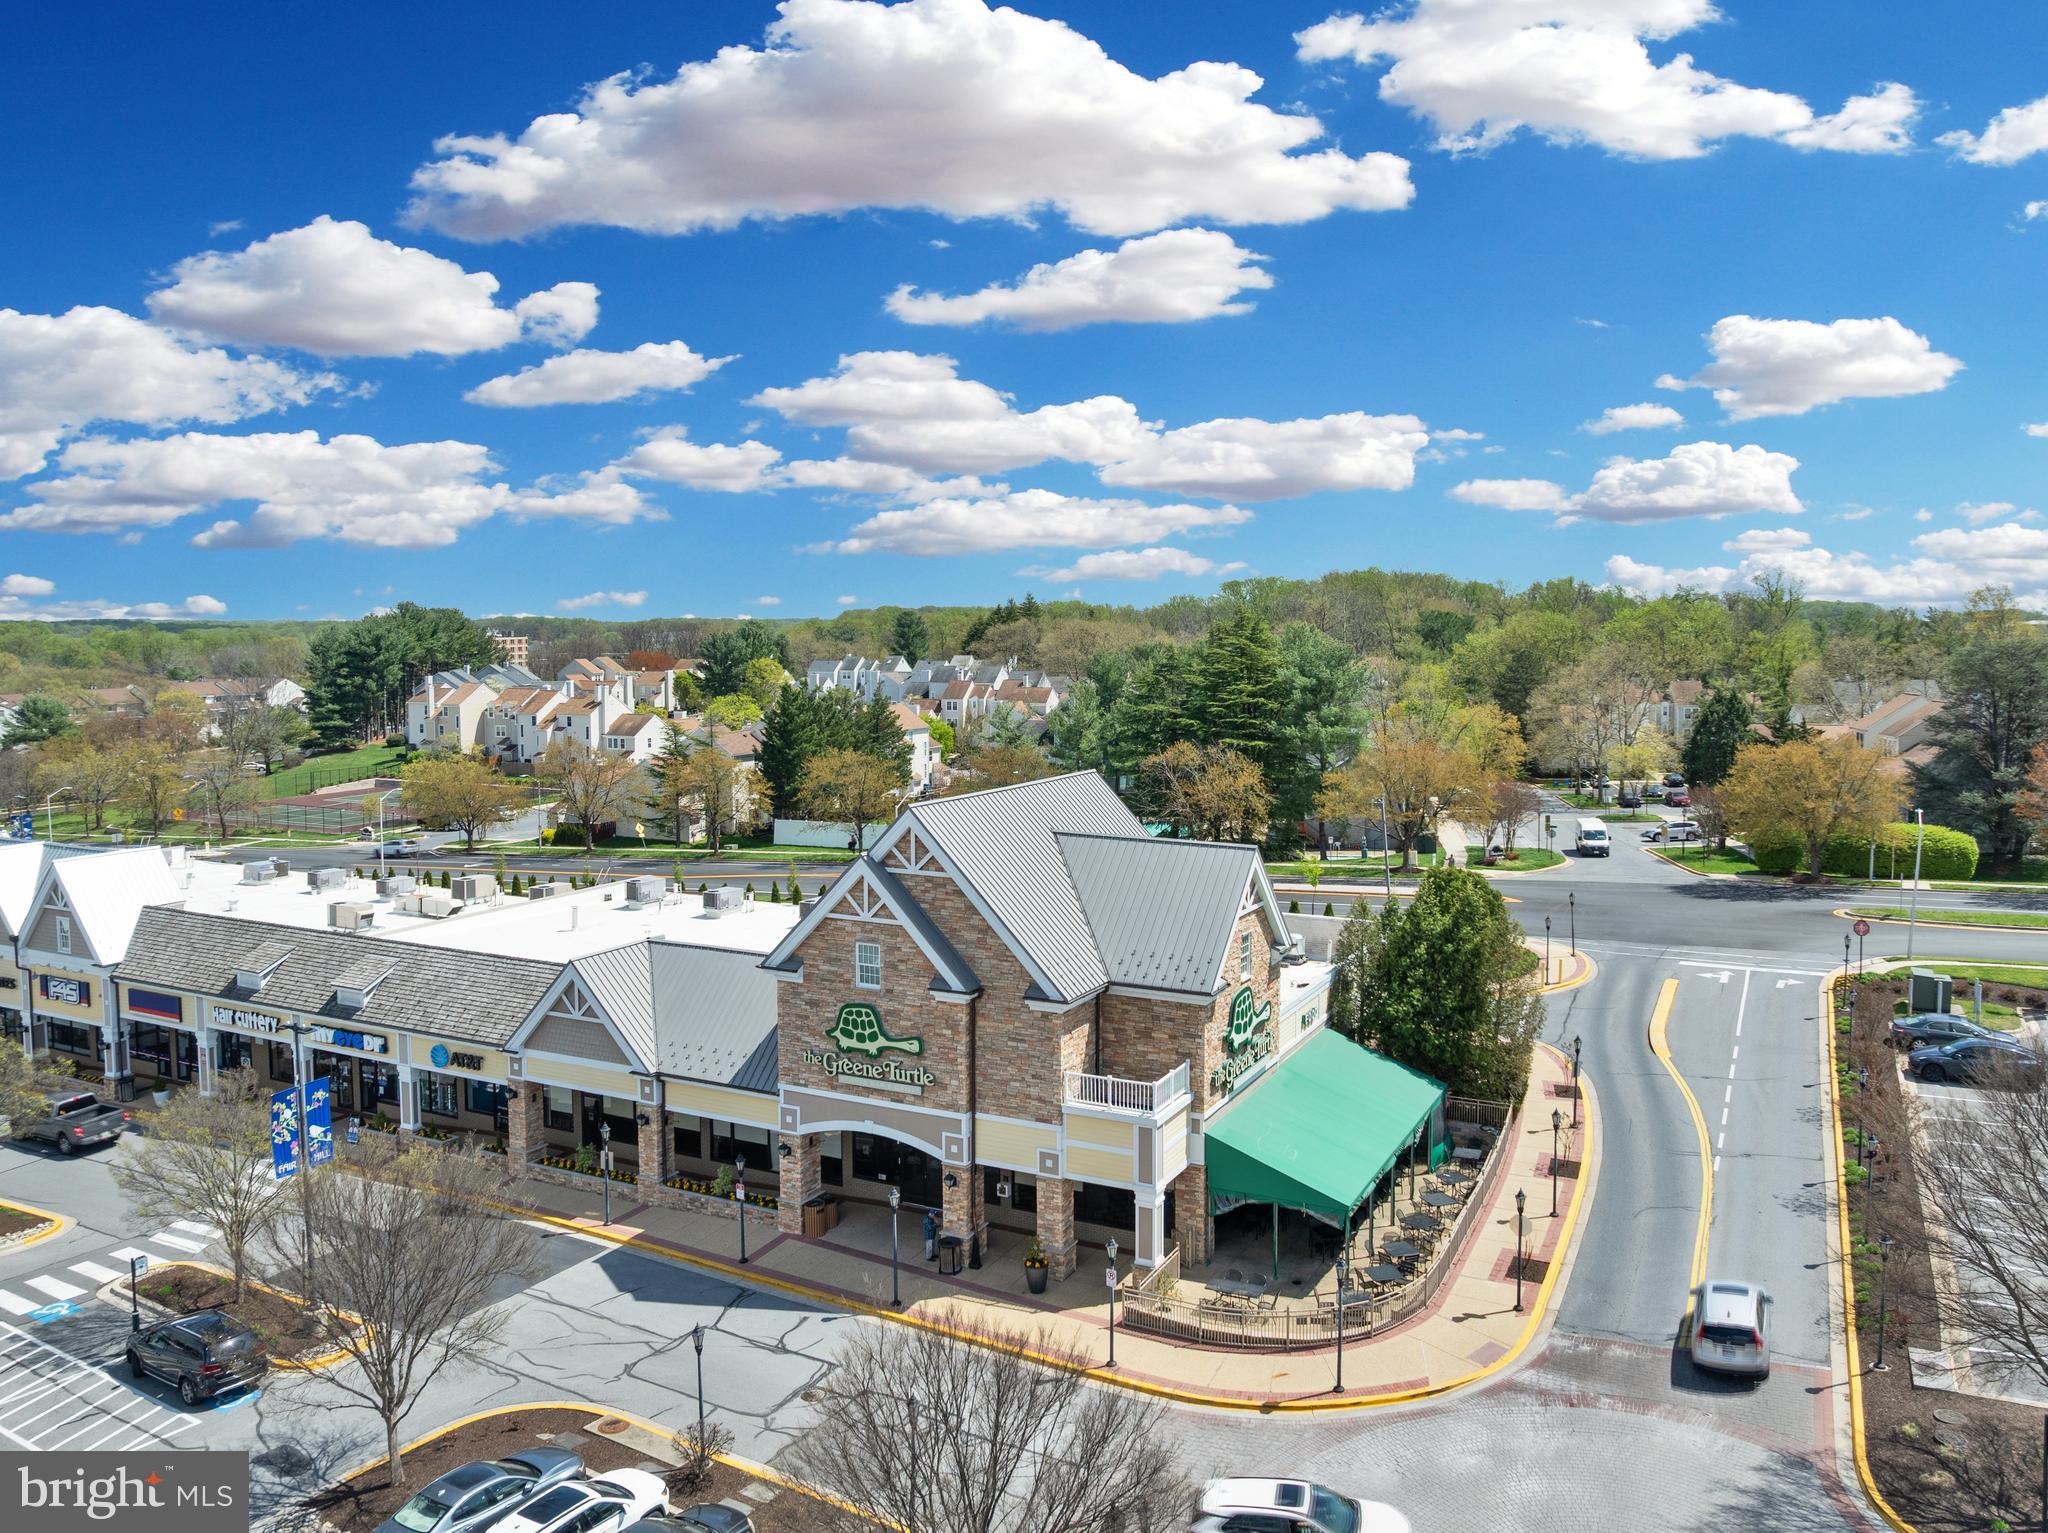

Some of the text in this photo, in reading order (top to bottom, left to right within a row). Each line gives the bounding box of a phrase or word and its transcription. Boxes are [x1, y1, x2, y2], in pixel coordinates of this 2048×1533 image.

[212, 1006, 234, 1025] Hair
[450, 1052, 484, 1071] AT&T
[802, 1050, 936, 1087] the Greene Turtle
[313, 1149, 331, 1162] HILL
[278, 1161, 297, 1174] FAIR
